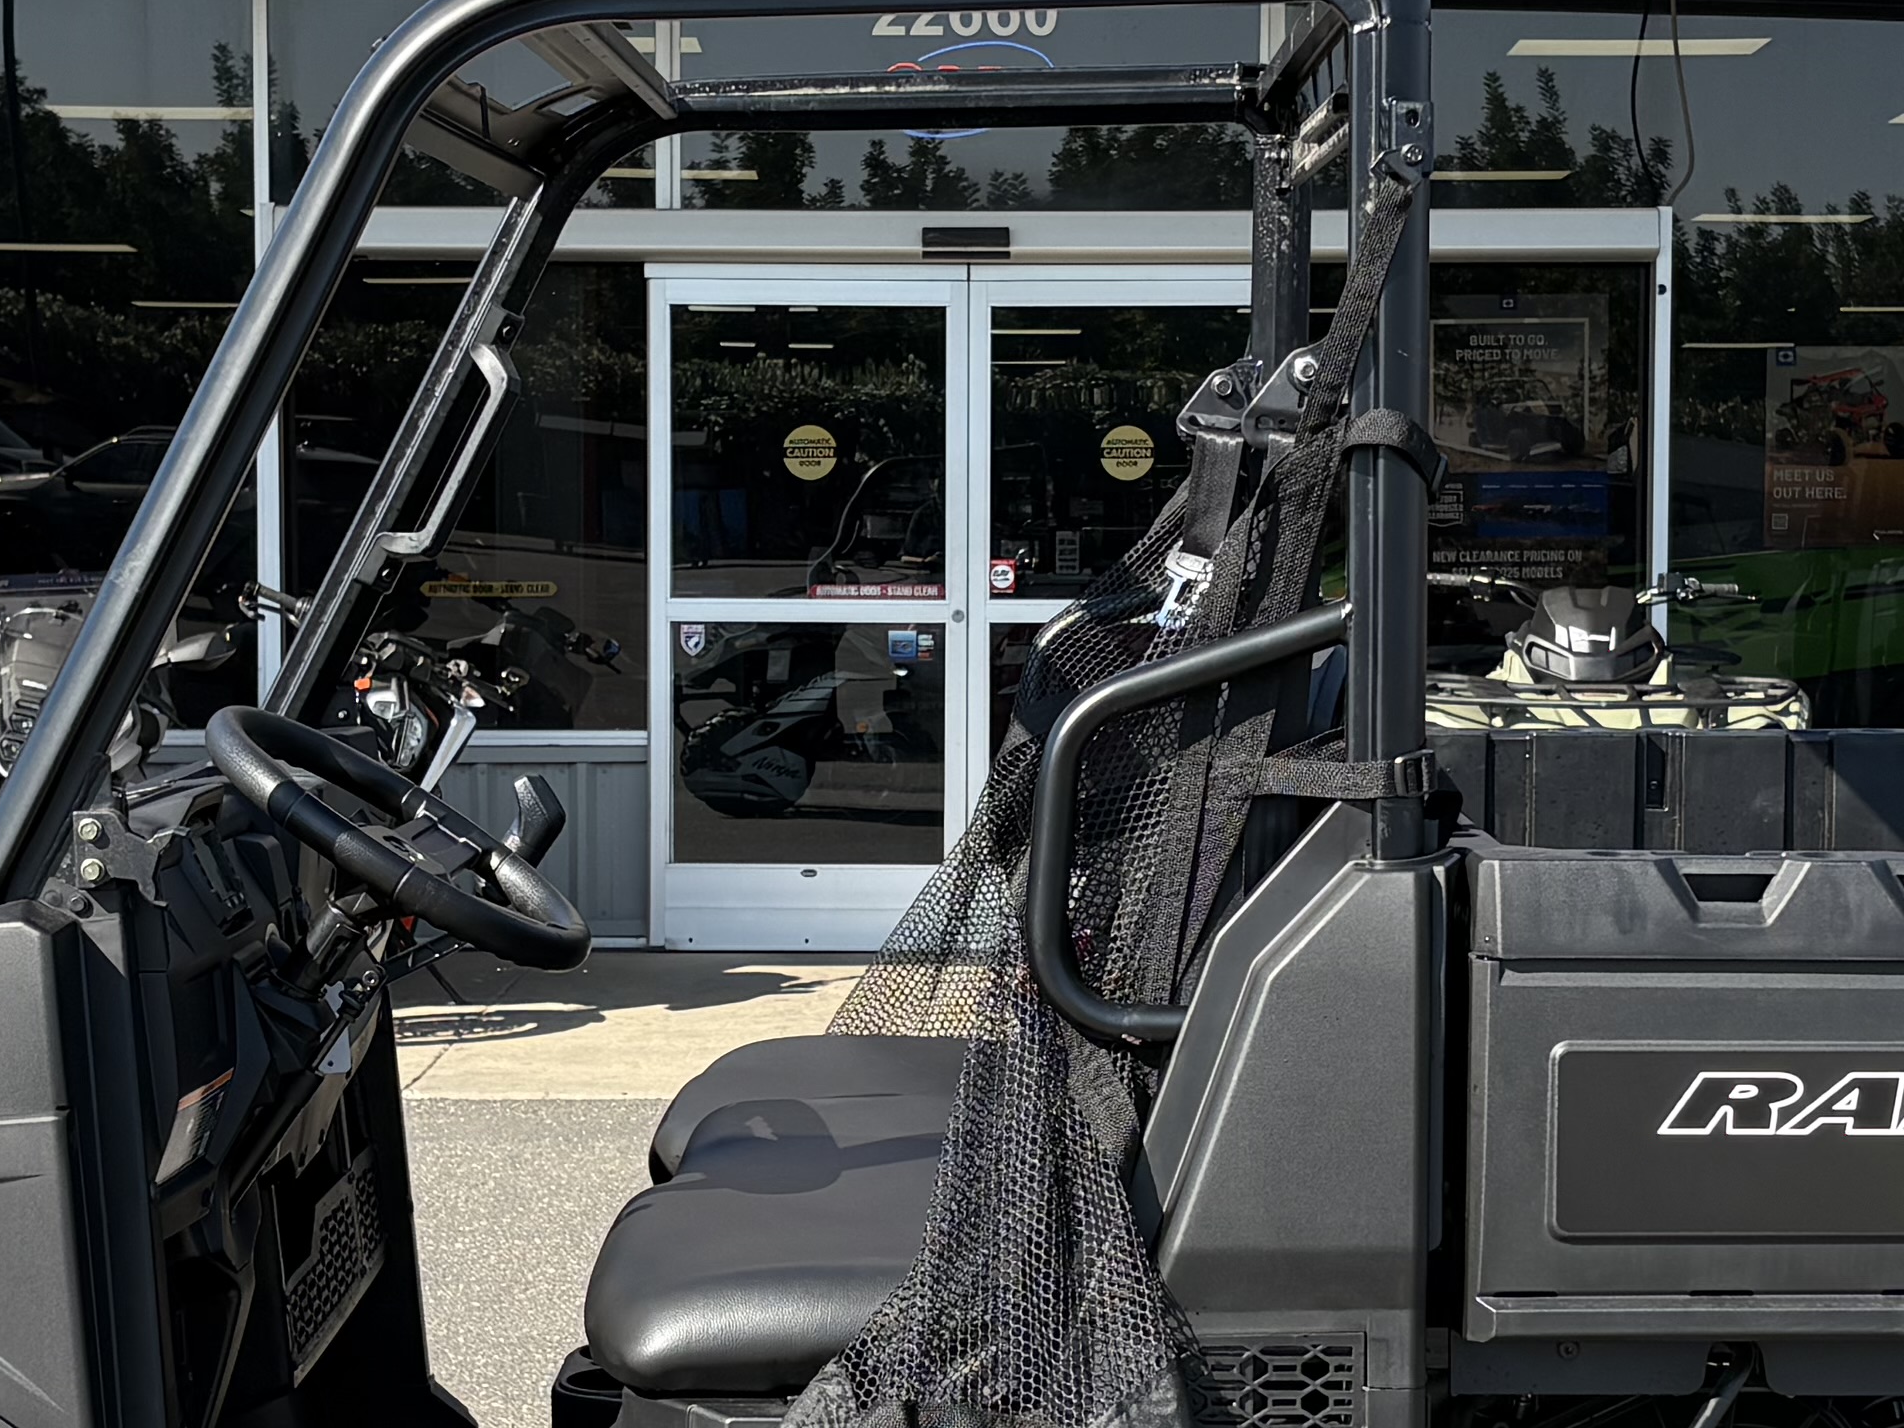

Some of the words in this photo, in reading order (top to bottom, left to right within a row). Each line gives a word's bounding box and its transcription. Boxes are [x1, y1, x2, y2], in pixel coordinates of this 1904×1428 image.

[1469, 335, 1506, 346] BUILT
[1508, 335, 1525, 346] TO
[1456, 349, 1501, 361] PRICED
[1505, 349, 1521, 360] TO
[786, 448, 834, 457] CAUTION
[1103, 448, 1151, 458] CAUTION
[1773, 470, 1809, 482] MEET
[1816, 470, 1834, 482] US
[1773, 487, 1802, 499] OUT
[1432, 551, 1458, 563] NEW
[1459, 551, 1521, 563] CLEARANCE
[1523, 550, 1565, 562] PRICING
[1521, 566, 1564, 579] MODELS
